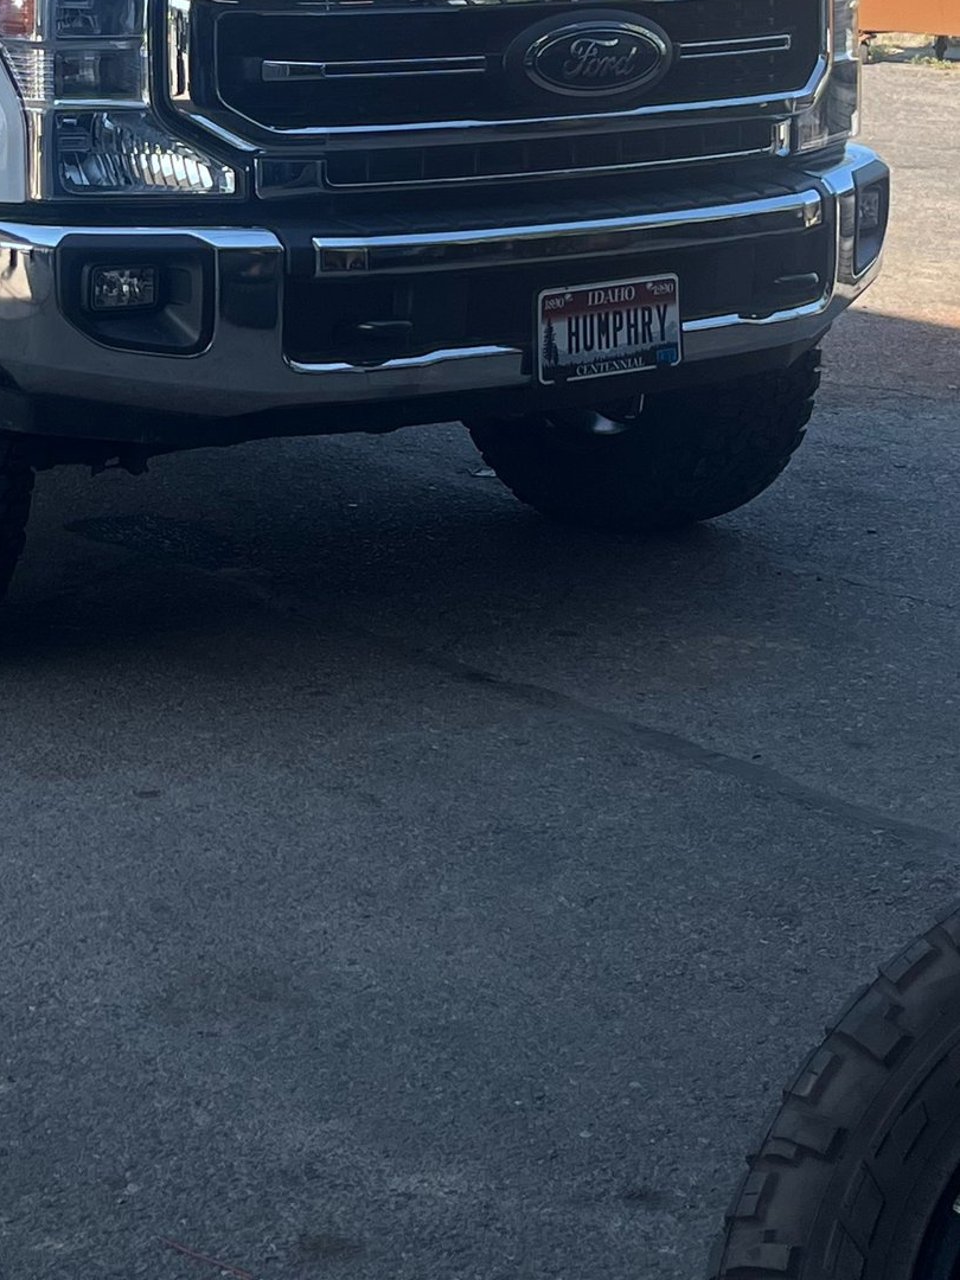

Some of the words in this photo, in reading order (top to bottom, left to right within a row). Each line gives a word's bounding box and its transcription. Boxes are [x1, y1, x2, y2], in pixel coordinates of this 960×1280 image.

[563, 37, 638, 78] Ford
[587, 285, 636, 306] IDAHO
[566, 304, 668, 354] HUMPHRY
[576, 357, 646, 376] CENTENNIAL
